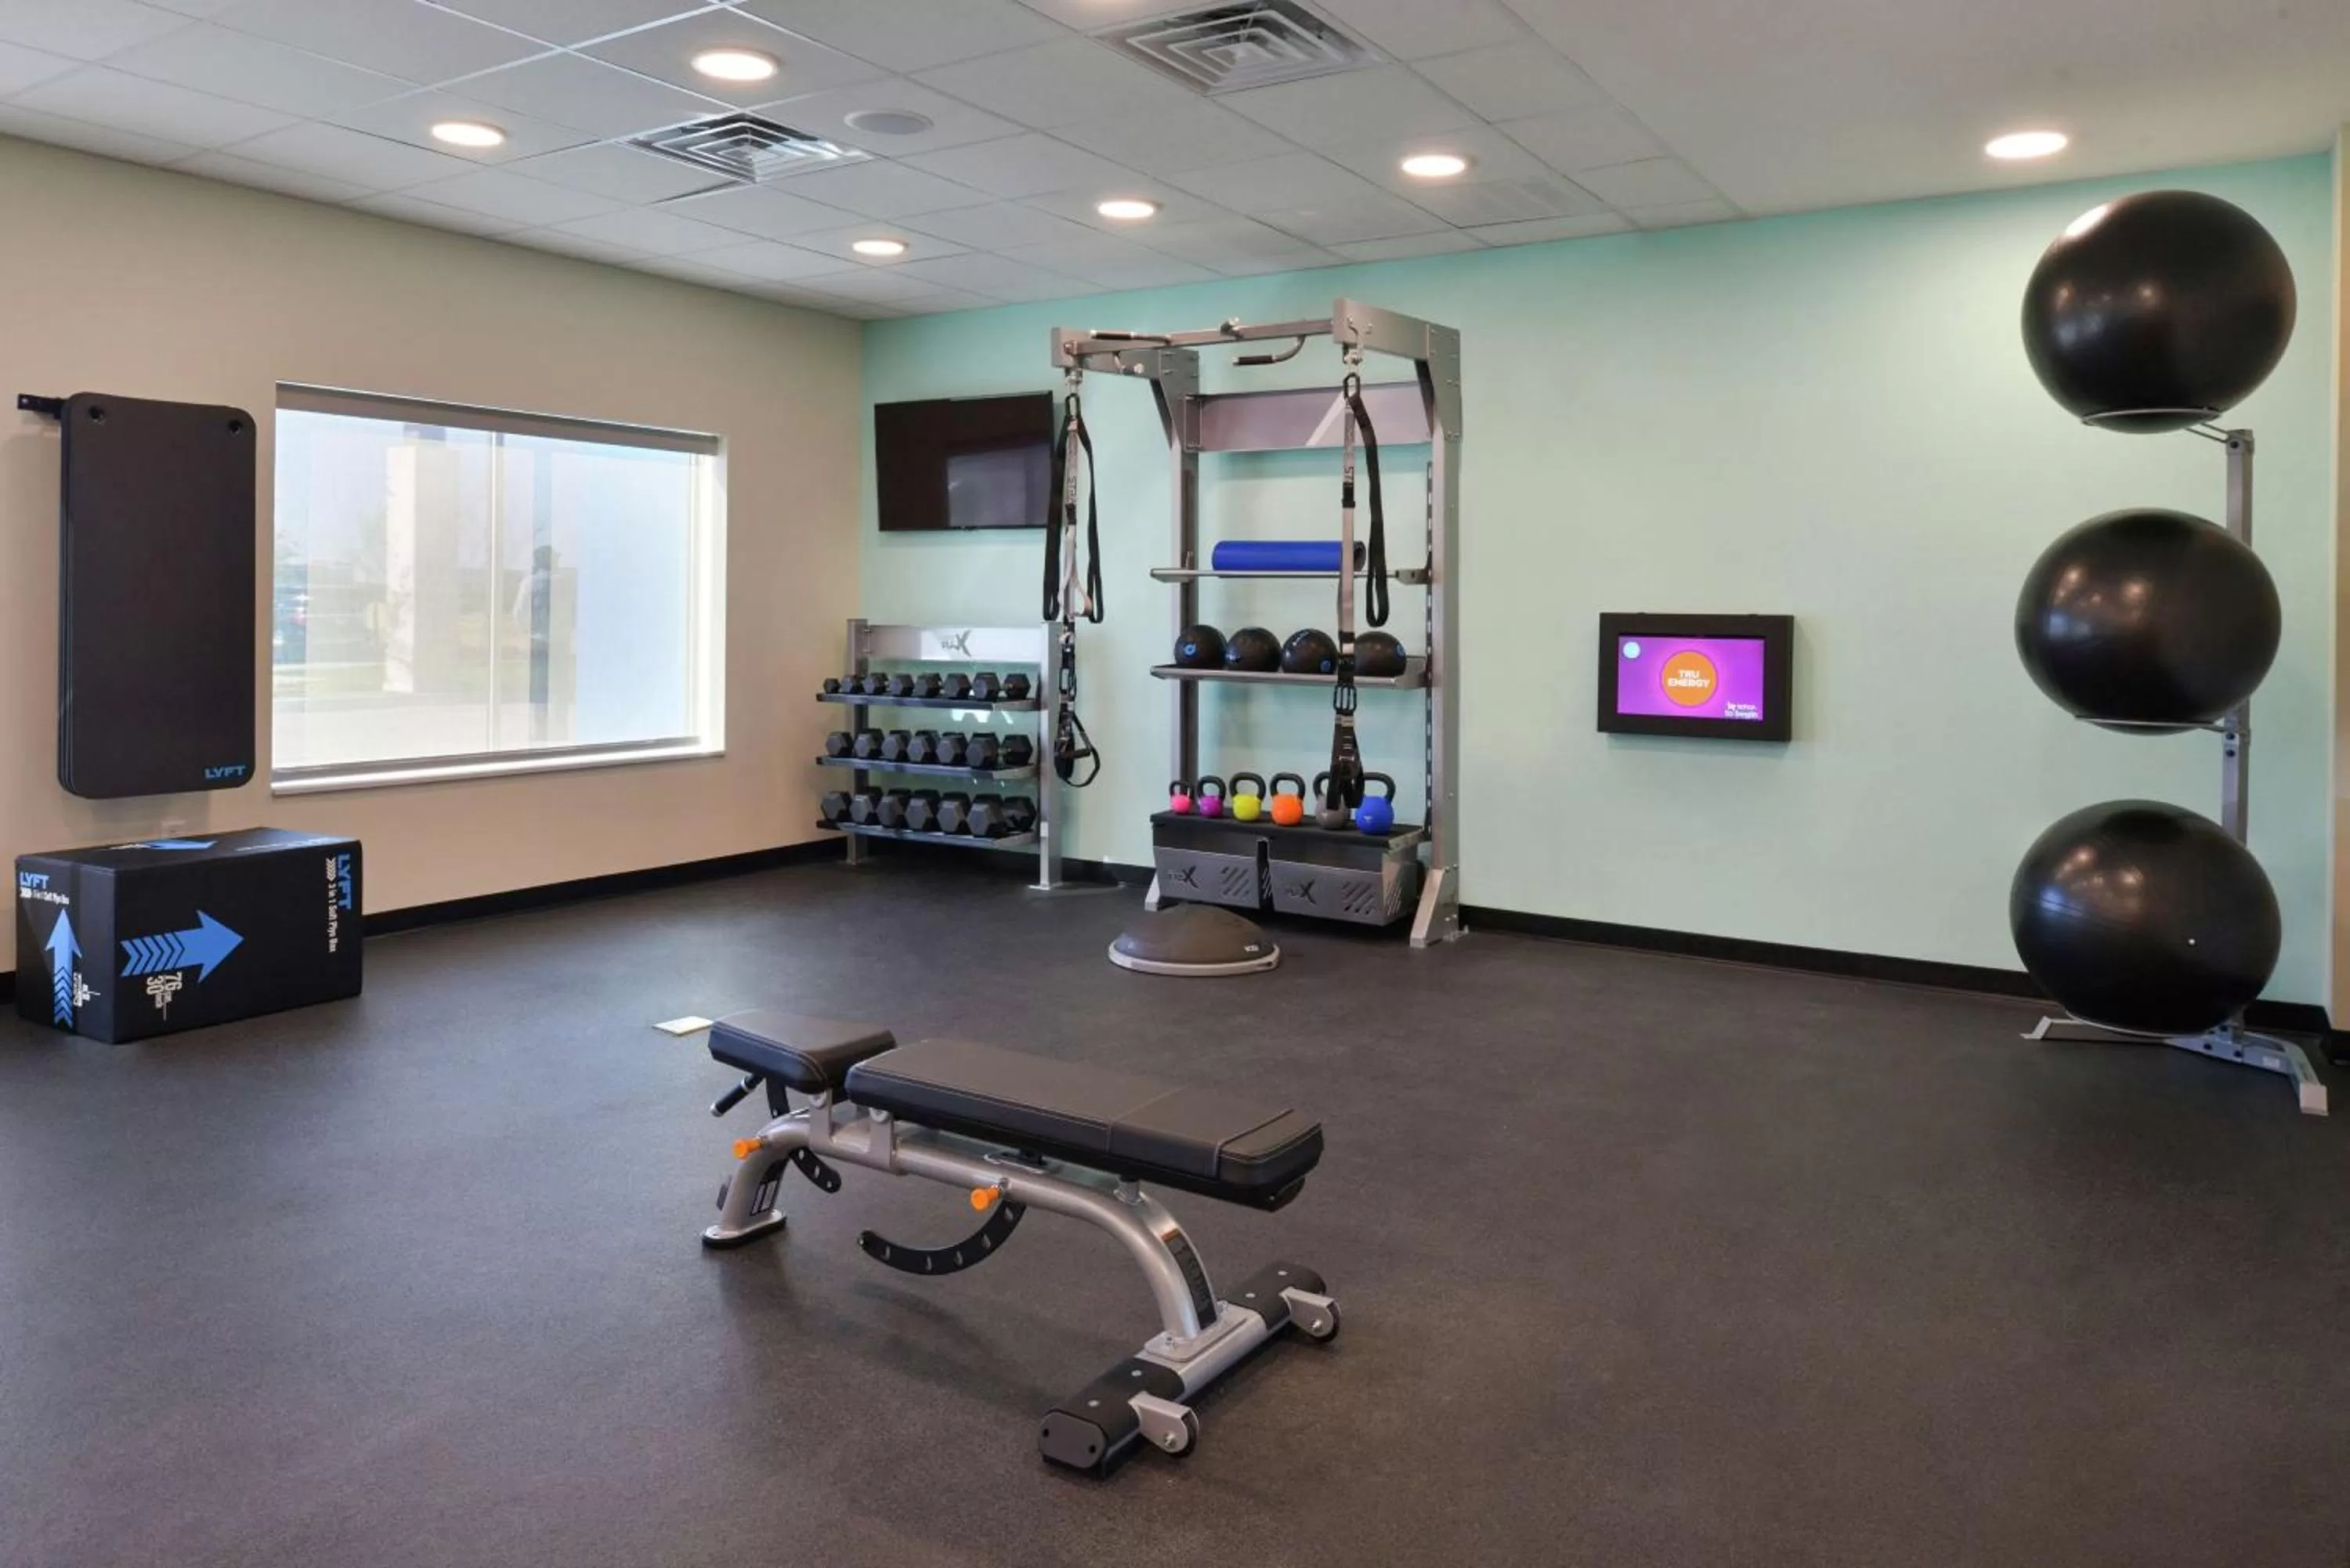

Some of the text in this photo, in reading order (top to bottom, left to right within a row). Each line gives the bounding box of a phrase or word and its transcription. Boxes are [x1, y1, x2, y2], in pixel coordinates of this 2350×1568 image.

[1667, 677, 1710, 688] ENERGY
[1679, 669, 1700, 678] TRU
[204, 764, 246, 779] LYFT
[20, 871, 50, 890] LYFT
[338, 853, 352, 910] LYFT
[146, 975, 164, 995] 30
[165, 971, 183, 990] 76
